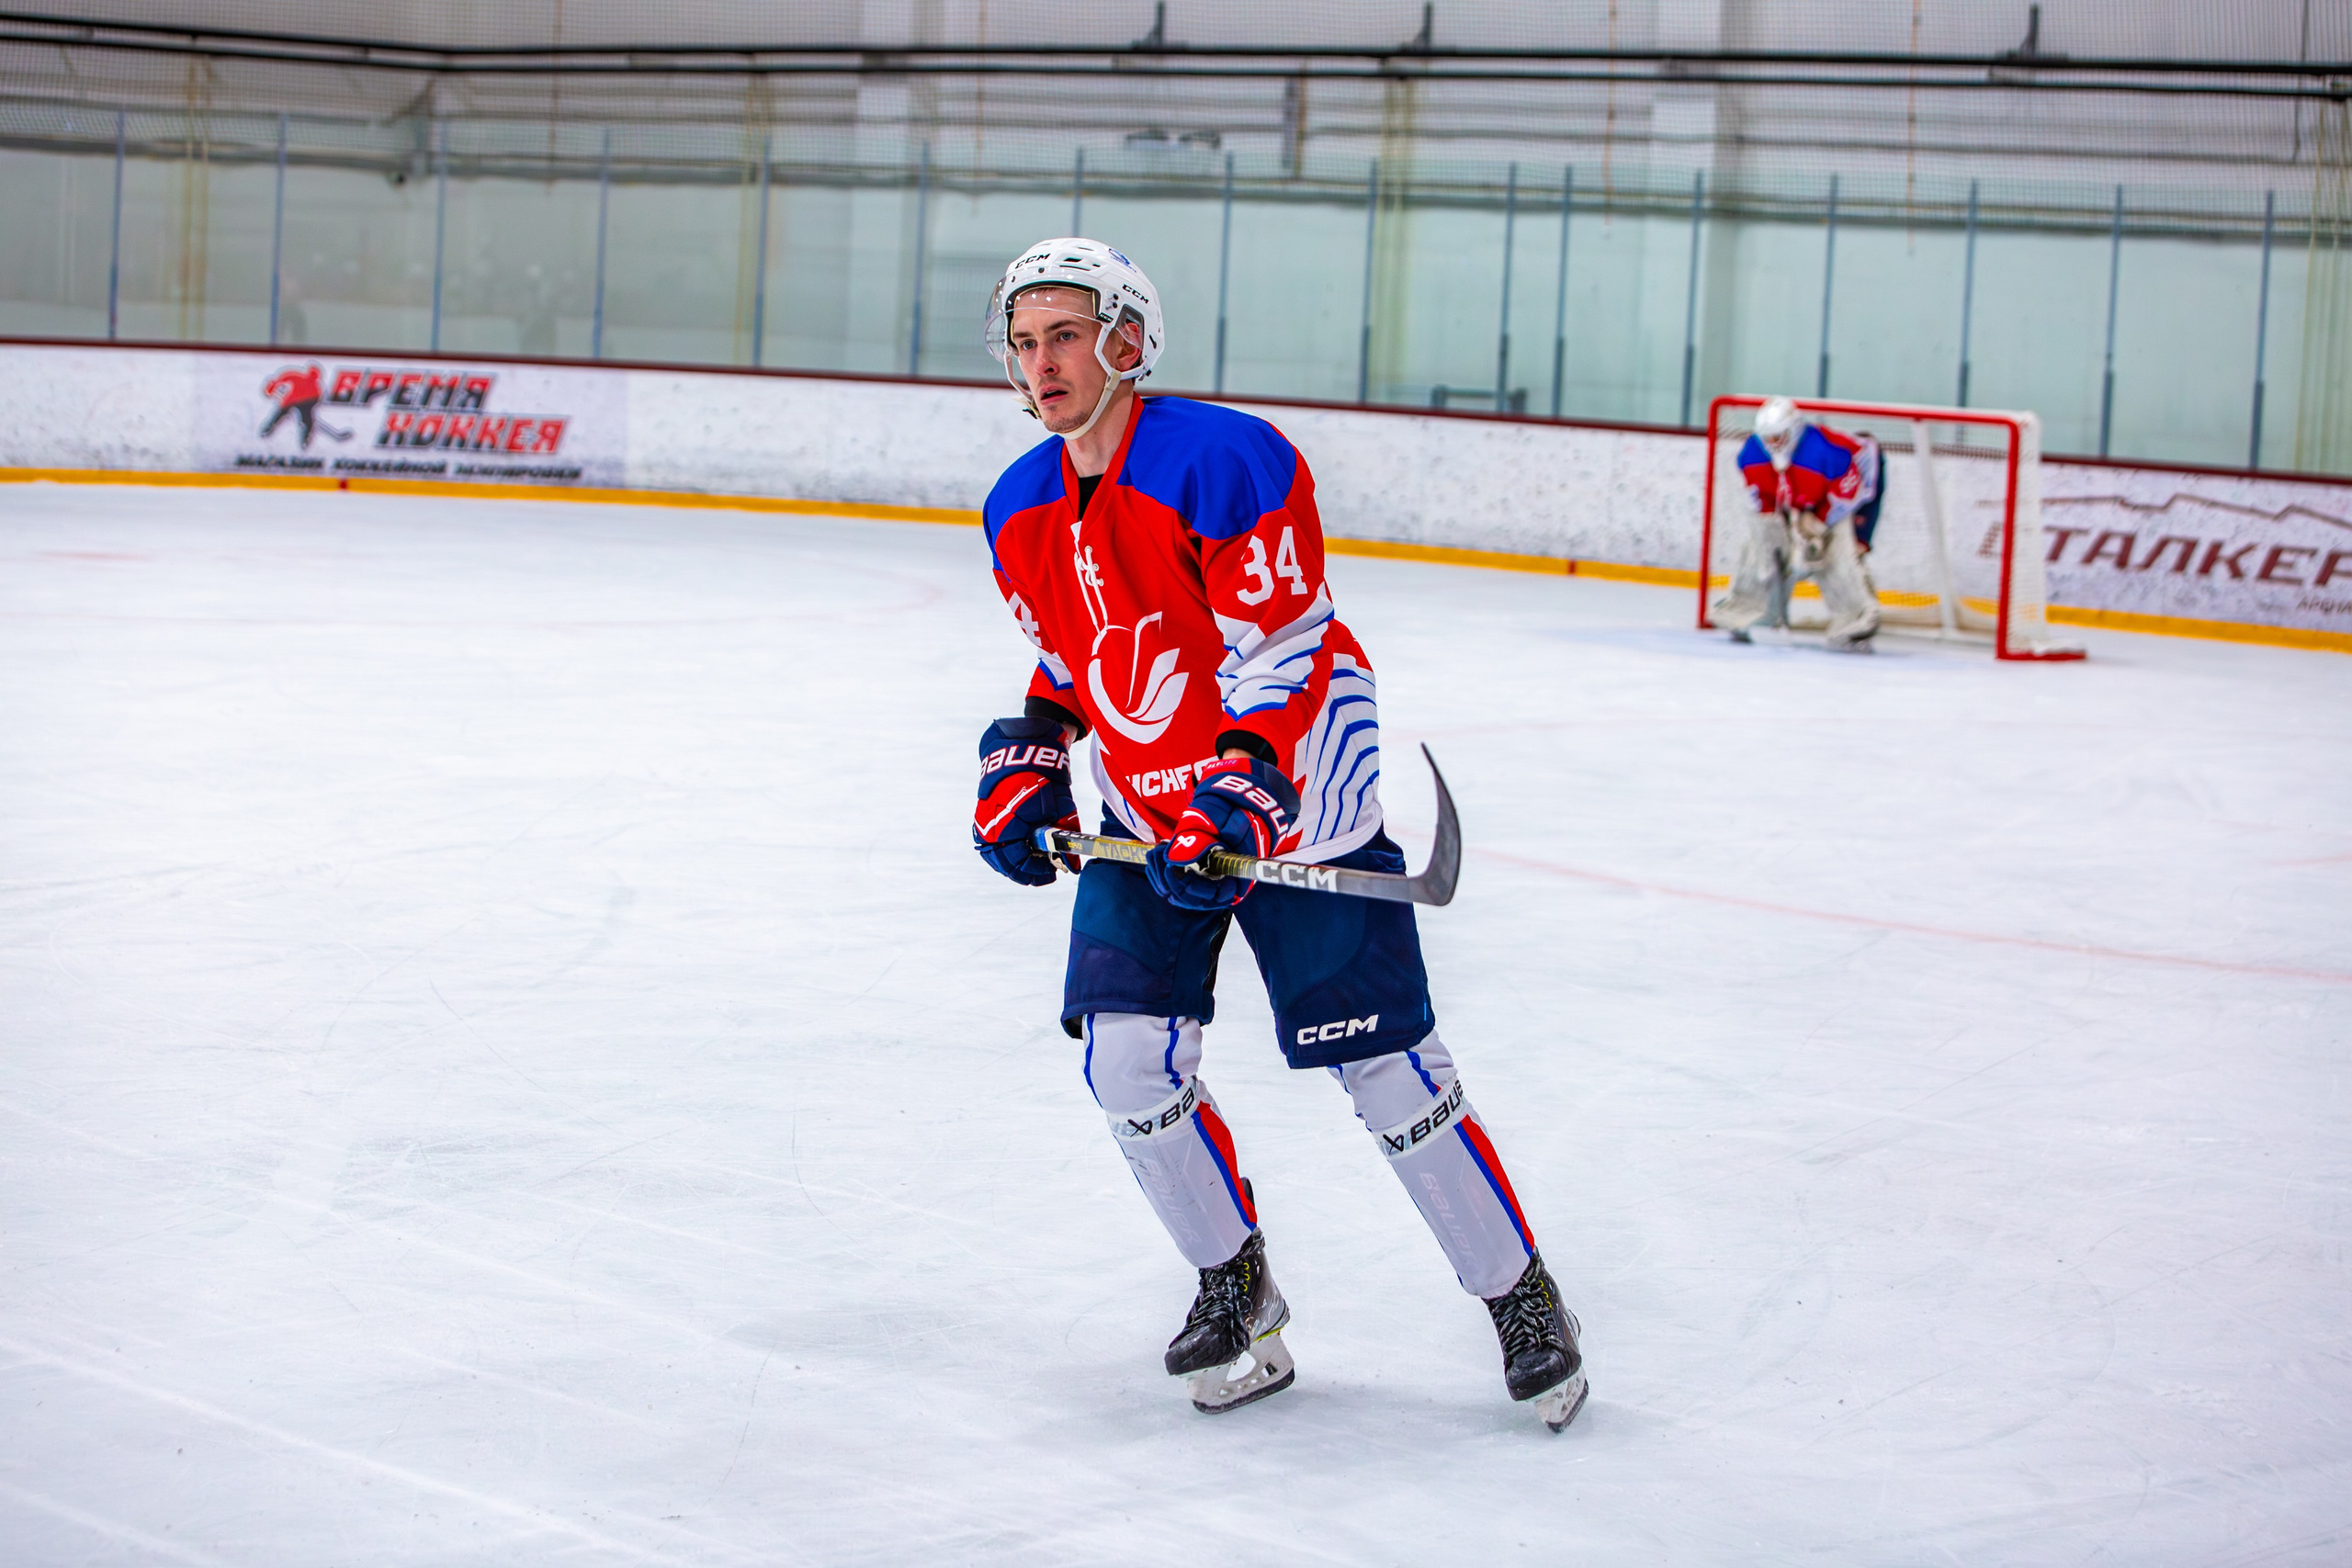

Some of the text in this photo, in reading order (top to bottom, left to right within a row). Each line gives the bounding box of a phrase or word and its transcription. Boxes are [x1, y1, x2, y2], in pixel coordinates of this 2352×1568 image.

[1014, 253, 1051, 269] CCM
[1122, 283, 1149, 304] CCM
[324, 367, 495, 410] ВРЕМЯ
[376, 412, 568, 454] ХОККЕЯ
[1236, 525, 1308, 606] 34
[1255, 860, 1339, 894] CCM
[1296, 1014, 1379, 1045] CCM
